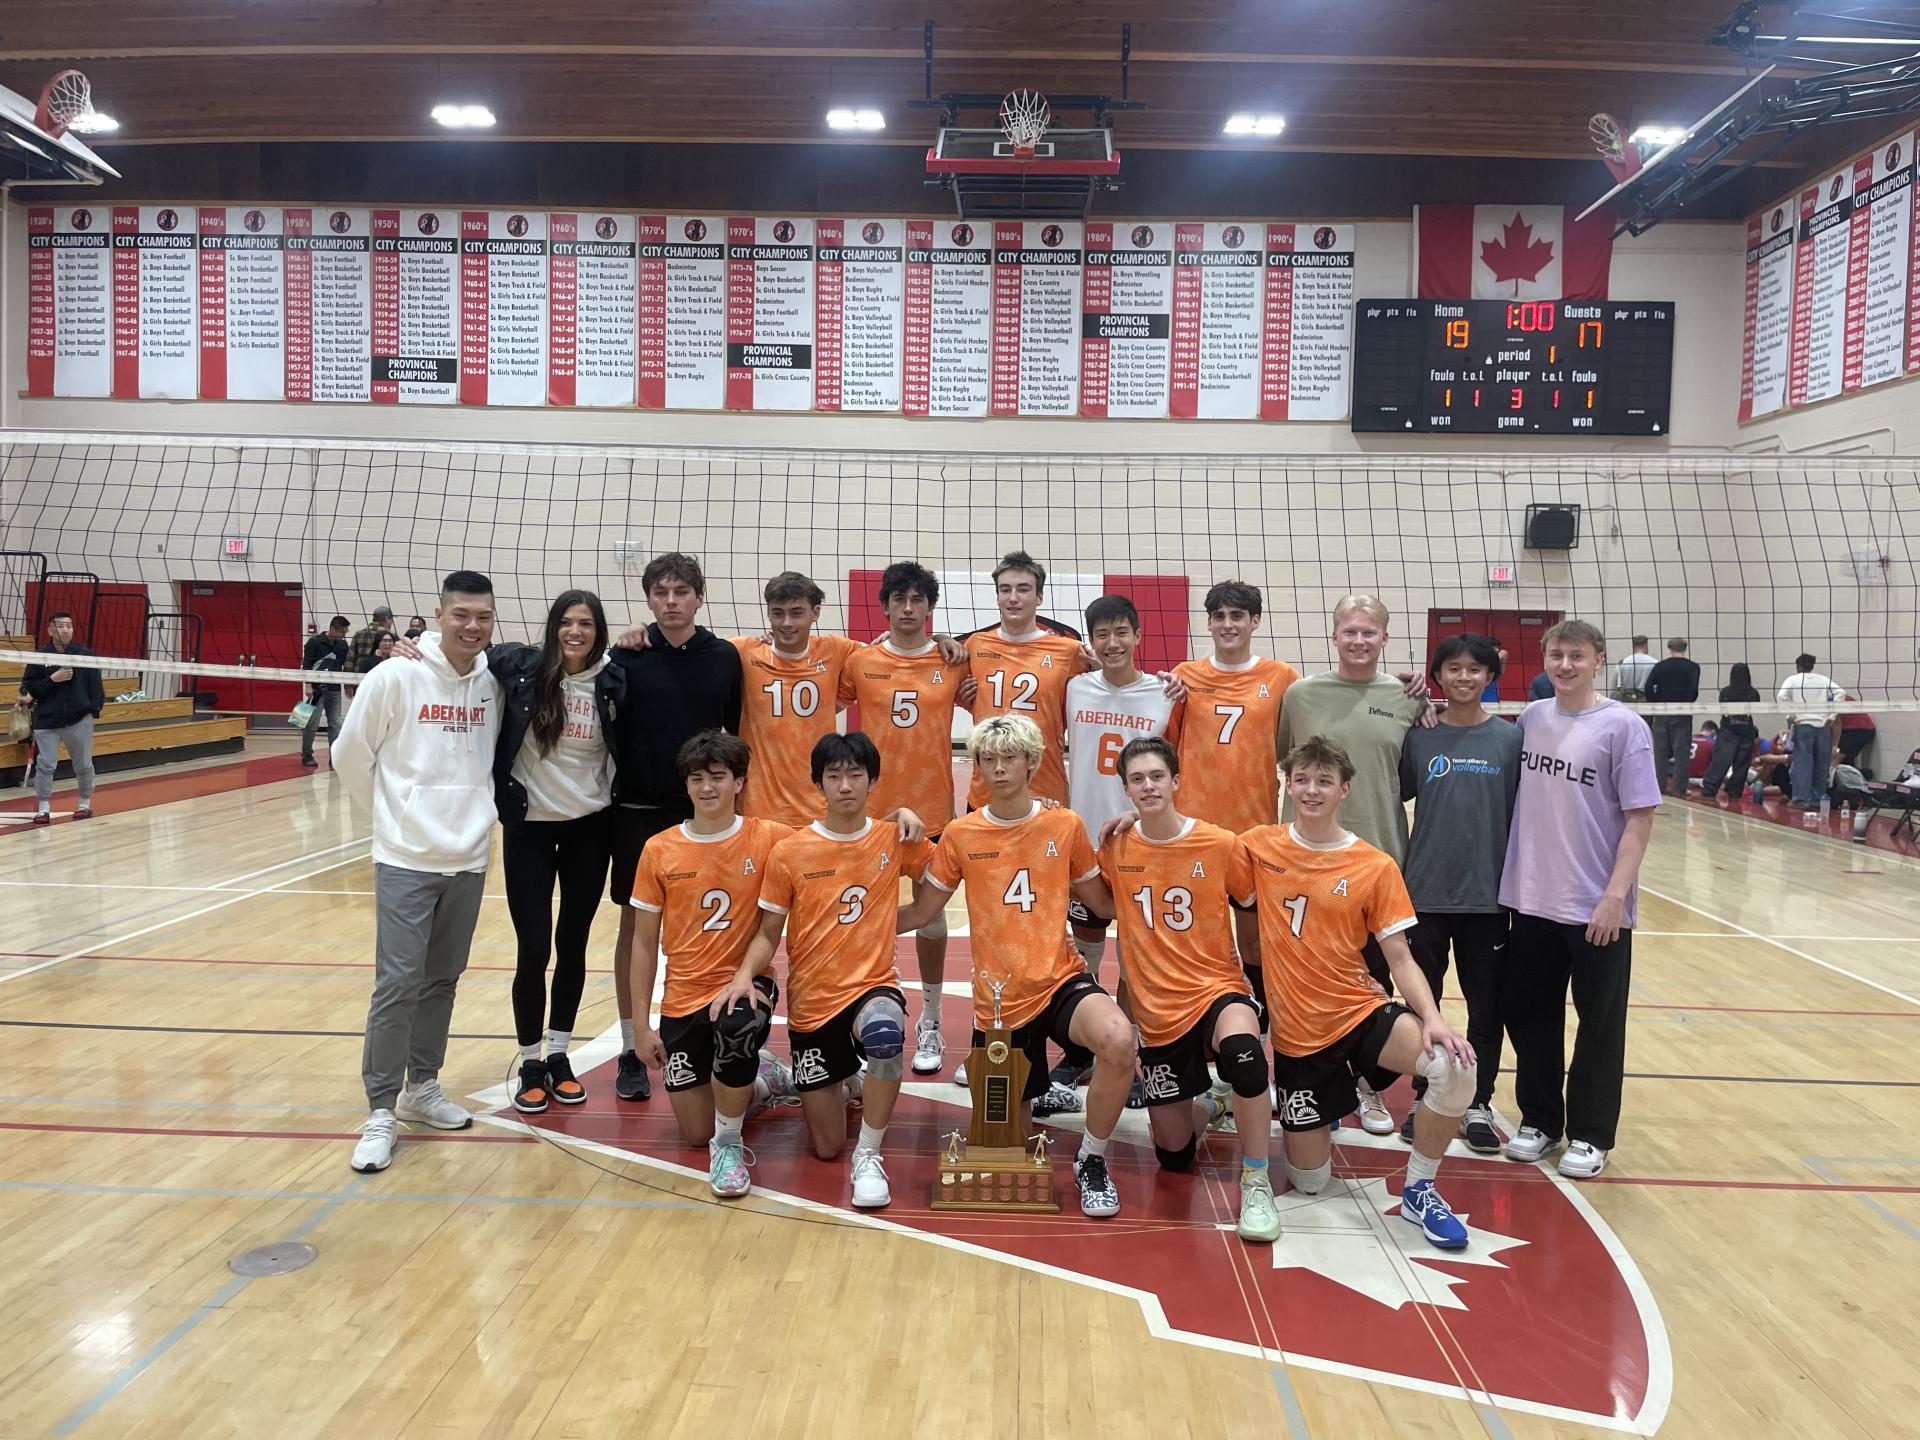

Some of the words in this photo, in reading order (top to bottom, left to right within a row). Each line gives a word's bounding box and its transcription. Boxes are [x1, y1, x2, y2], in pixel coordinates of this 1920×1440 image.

[1855, 190, 1870, 208] CITY
[1870, 170, 1910, 201] CHAMPIONS
[114, 216, 137, 225] 1940's
[200, 217, 224, 227] 1940's
[286, 218, 309, 227] 1950's
[374, 220, 398, 229] 1950's
[463, 221, 487, 231] 1960's
[551, 223, 576, 233] 1960's
[640, 226, 664, 235] 1970's
[729, 227, 753, 237] 1970's
[818, 229, 842, 239] 1980's
[31, 237, 50, 247] CITY
[51, 236, 105, 247] CHAMPIONS
[116, 236, 135, 247] CITY
[137, 236, 192, 248] CHAMPIONS
[907, 231, 931, 241] 1980's
[996, 231, 1021, 241] 1980's
[1086, 232, 1111, 242] 1980's
[1177, 233, 1201, 243] 1990's
[1268, 234, 1292, 244] 1990's
[202, 238, 222, 248] CITY
[224, 238, 279, 249] CHAMPIONS
[287, 239, 308, 249] CITY
[310, 239, 365, 250] CHAMPIONS
[375, 239, 396, 250] CITY
[397, 240, 453, 252] CHAMPIONS
[464, 242, 485, 253] CITY
[486, 242, 542, 254] CHAMPIONS
[553, 244, 572, 255] CITY
[575, 244, 631, 257] CHAMPIONS
[642, 247, 662, 257] CITY
[664, 247, 720, 258] CHAMPIONS
[731, 248, 751, 259] CITY
[753, 248, 808, 259] CHAMPIONS
[819, 249, 840, 260] CITY
[841, 249, 897, 261] CHAMPIONS
[908, 252, 928, 262] CITY
[930, 252, 987, 263] CHAMPIONS
[998, 252, 1018, 263] CITY
[1020, 252, 1077, 264] CHAMPIONS
[1087, 253, 1108, 265] CITY
[1110, 254, 1167, 265] CHAMPIONS
[1178, 254, 1199, 265] CITY
[1201, 254, 1258, 265] CHAMPIONS
[1269, 255, 1290, 266] CITY
[1291, 255, 1349, 266] CHAMPIONS
[497, 260, 510, 268] Boys
[511, 260, 539, 268] Basketball
[756, 265, 769, 273] Boys
[1120, 271, 1133, 279] Boys
[852, 286, 865, 294] Boys
[1434, 304, 1464, 317] Home
[1564, 305, 1601, 319] Guests
[1100, 315, 1150, 326] PROVINCIAL
[1506, 303, 1554, 331] 1:00
[1099, 327, 1150, 338] CHAMPIONS
[1446, 320, 1469, 349] 19
[1578, 321, 1602, 349] 17
[743, 345, 793, 356] PROVINCIAL
[1498, 349, 1531, 364] period
[1549, 345, 1557, 364] 1
[388, 359, 438, 370] PROVINCIAL
[743, 356, 793, 367] CHAMPIONS
[388, 370, 438, 381] CHAMPIONS
[1430, 369, 1455, 381] fouls
[1496, 368, 1531, 383] player
[1572, 370, 1597, 383] fouls
[1445, 388, 1451, 408] 1
[1474, 388, 1480, 408] 1
[1510, 387, 1523, 409] 3
[1553, 389, 1560, 409] 1
[1587, 389, 1594, 409] 1
[1431, 415, 1451, 426] won
[1498, 416, 1525, 428] game
[1572, 417, 1593, 427] won
[229, 540, 244, 553] EXIT
[1493, 567, 1509, 580] EXIT
[815, 659, 827, 673] A
[1040, 654, 1053, 669] A
[931, 670, 944, 685] A
[986, 670, 1039, 711] 12
[1258, 683, 1270, 699] A
[763, 679, 820, 718] 10
[890, 690, 920, 729] 5
[1075, 709, 1156, 732] ABERHART
[1214, 704, 1245, 745] 7
[443, 725, 472, 734] ATHLETIC
[1096, 732, 1124, 776] 6
[1452, 764, 1500, 776] volleyball
[1521, 750, 1597, 787] PURPLE
[1046, 841, 1059, 857] A
[743, 858, 757, 876] A
[1191, 861, 1206, 878] A
[1003, 868, 1037, 913] 4
[1332, 878, 1348, 897] A
[700, 888, 732, 932] 2
[838, 884, 869, 924] 3
[1132, 885, 1194, 932] 13
[1283, 893, 1309, 939] 1
